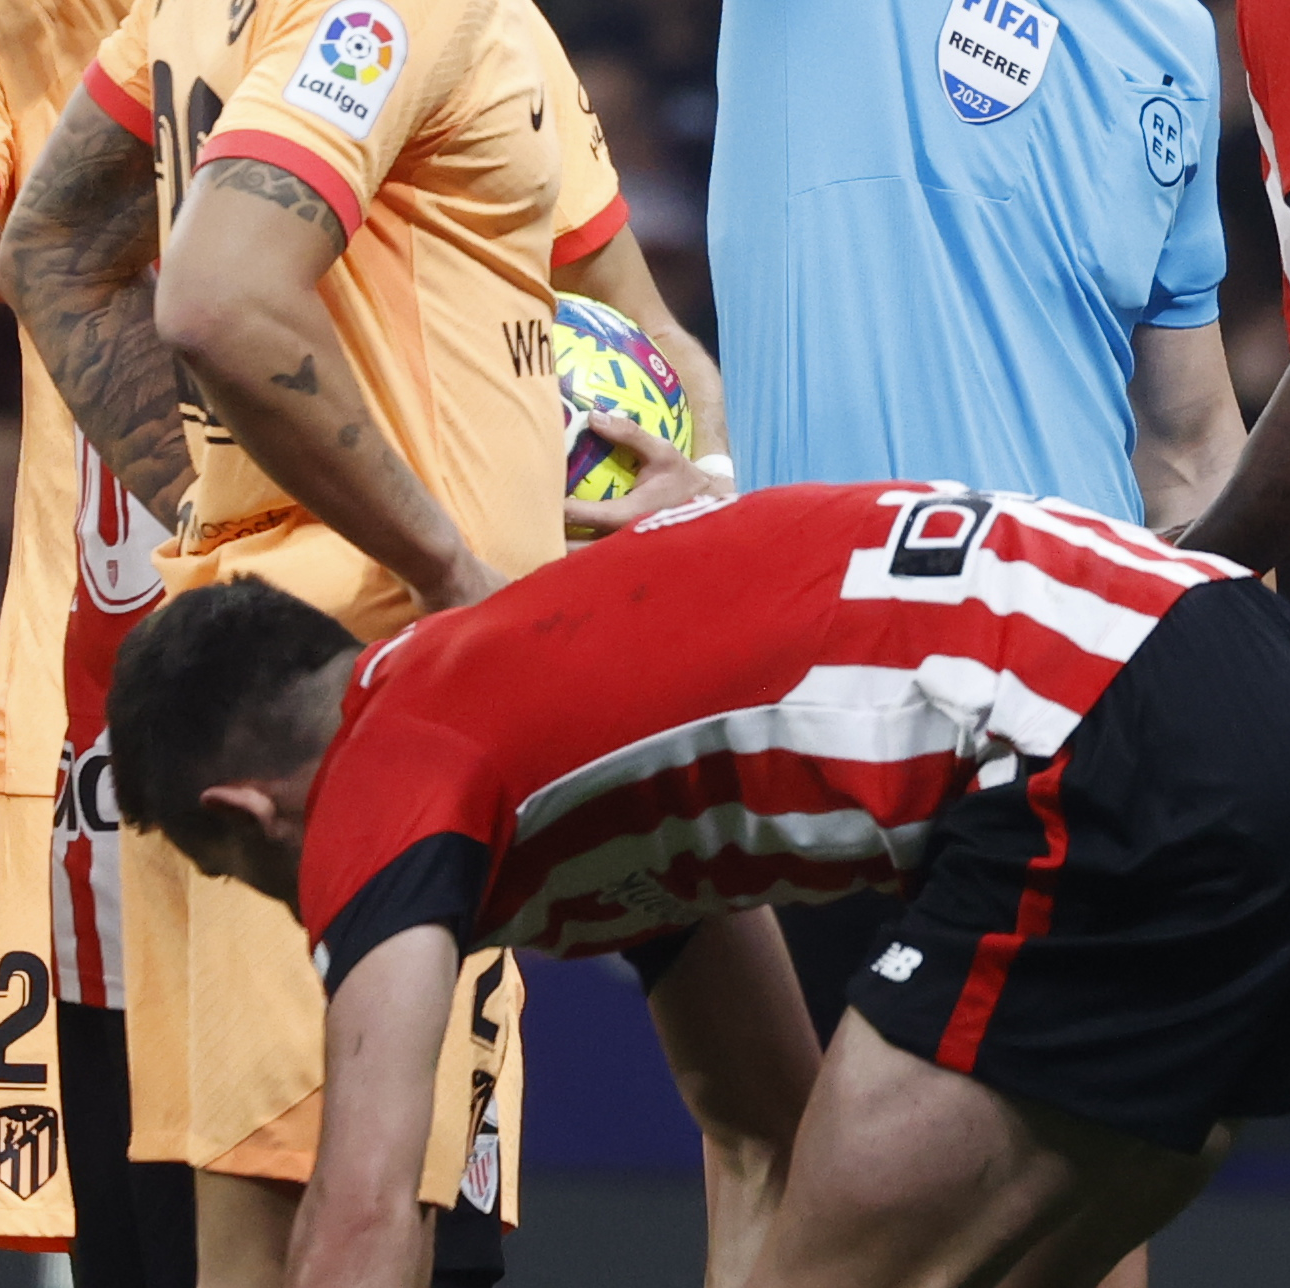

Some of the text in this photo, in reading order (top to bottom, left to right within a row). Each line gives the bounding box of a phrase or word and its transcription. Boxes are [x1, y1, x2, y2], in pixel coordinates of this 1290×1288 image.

[948, 30, 1031, 86] REFEREE
[298, 73, 369, 120] LaLiga
[952, 83, 992, 115] 2023
